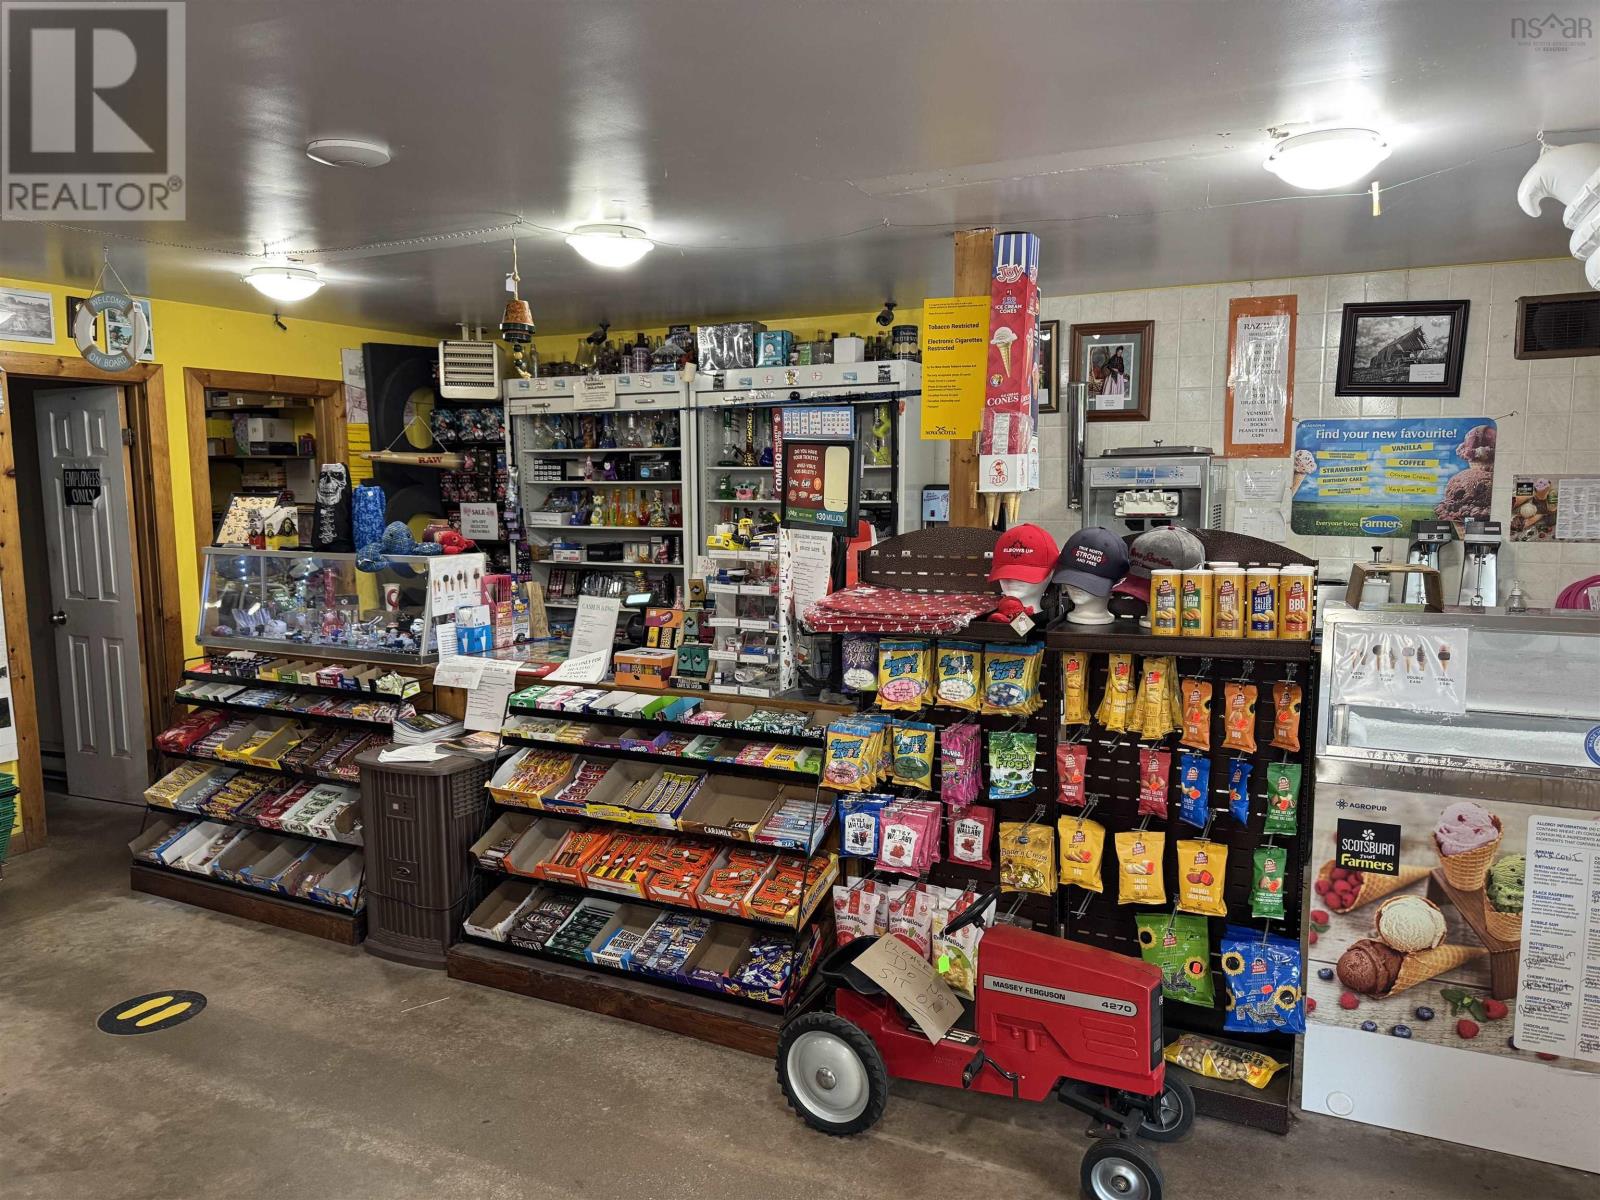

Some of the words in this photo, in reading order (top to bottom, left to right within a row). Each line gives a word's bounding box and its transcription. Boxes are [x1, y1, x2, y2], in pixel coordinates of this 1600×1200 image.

[90, 295, 127, 307] WELCOME
[951, 321, 980, 329] Restricted
[89, 352, 101, 365] ON
[104, 355, 127, 368] BOARD
[987, 396, 1019, 407] CONES
[1316, 429, 1340, 439] Find
[1343, 430, 1369, 441] your
[1372, 430, 1398, 439] new
[1401, 428, 1457, 439] favourite!
[1391, 444, 1422, 452] VANILLA
[418, 456, 444, 464] RAW
[775, 453, 783, 492] COMBO
[1322, 466, 1368, 474] STRAWBERRY
[64, 470, 101, 487] EMPLOYEES
[71, 489, 97, 503] ONLY
[826, 514, 844, 523] MILLION
[1315, 520, 1342, 528] Everyone
[1360, 517, 1403, 530] Farmers
[1075, 550, 1102, 562] STRONG
[1088, 548, 1104, 556] NORTH
[1288, 598, 1306, 611] BBQ
[986, 658, 1026, 672] Sweet
[828, 738, 864, 751] Sweet
[996, 748, 1028, 760] Leaping
[996, 759, 1029, 770] Frogs
[1349, 802, 1388, 812] AGROPUR
[703, 826, 732, 838] CARAMILK
[848, 821, 872, 831] WALLABY
[956, 828, 982, 838] WALLABY
[1340, 853, 1394, 872] Farmers
[848, 915, 868, 927] Mallow
[902, 917, 924, 928] Mallow
[944, 936, 966, 950] Mallow
[1528, 940, 1564, 950] BUTTERSCOTCH
[879, 967, 912, 989] SIT
[915, 993, 944, 1014] ON
[926, 983, 956, 1009] NOT
[992, 980, 1024, 992] MASSEY
[1025, 987, 1066, 1001] FERGUSON
[1101, 1001, 1132, 1014] 4270
[1523, 1022, 1550, 1031] CHOCOLATE
